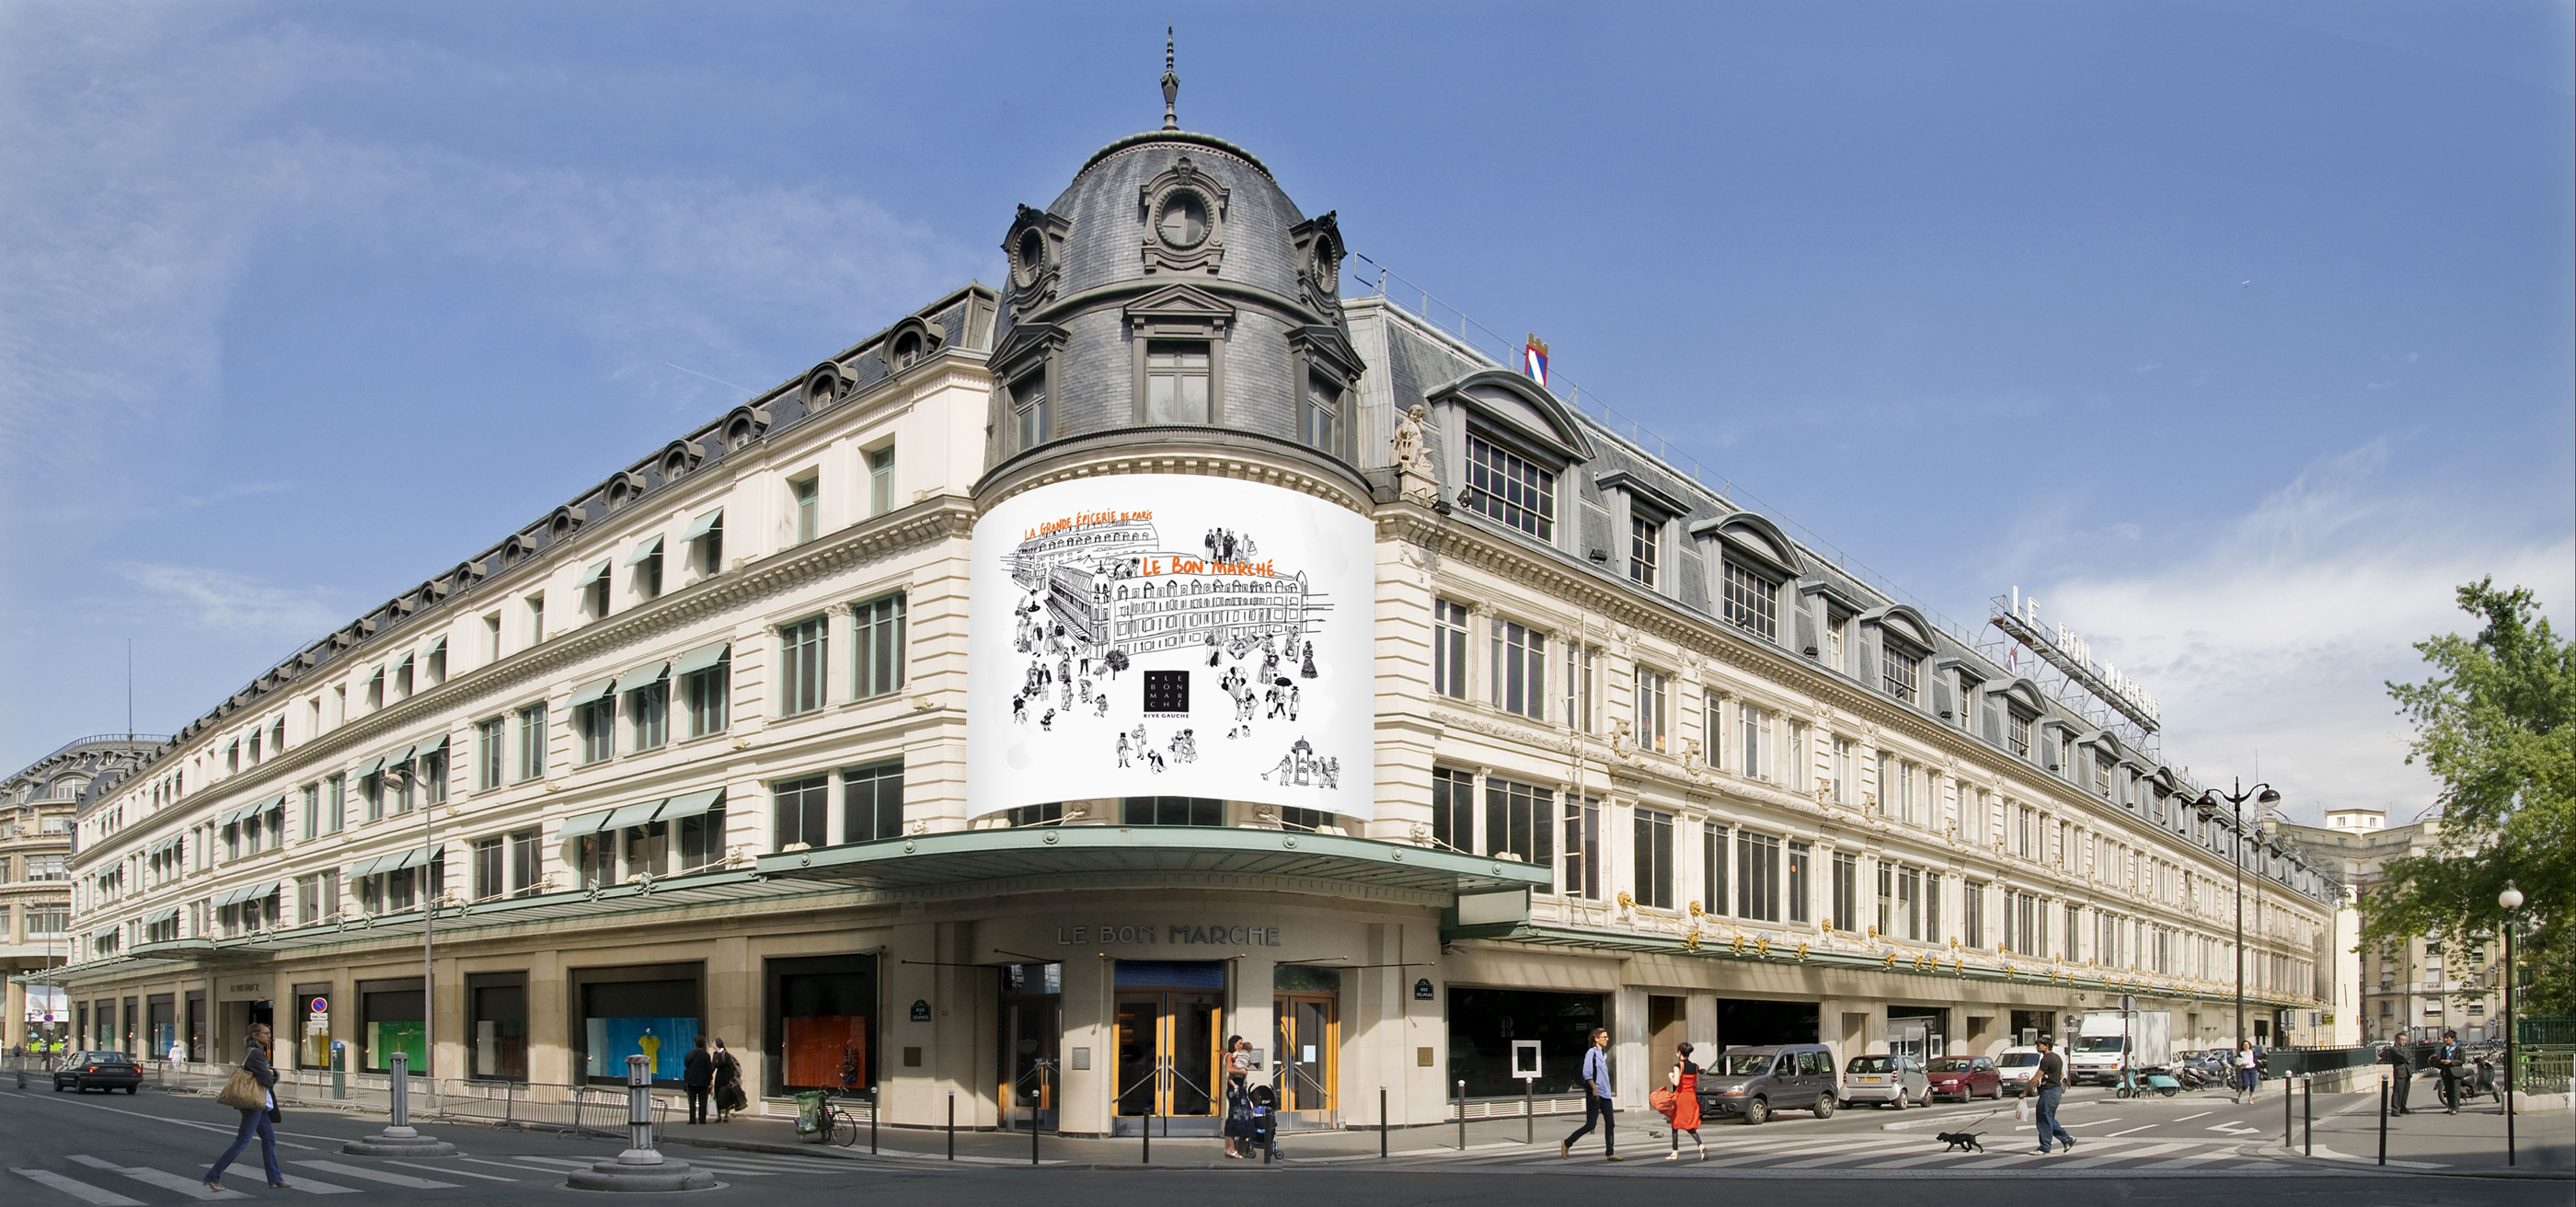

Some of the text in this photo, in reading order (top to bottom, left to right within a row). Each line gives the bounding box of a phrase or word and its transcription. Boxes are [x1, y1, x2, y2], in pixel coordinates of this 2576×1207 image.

[1024, 528, 1036, 541] LA
[1040, 517, 1073, 535] GRANDE
[1121, 512, 1130, 522] DE
[1143, 556, 1275, 577] LE BON MARCHÉ
[2013, 585, 2040, 633] LE
[2059, 621, 2090, 672] BON
[1058, 925, 1281, 947] LE BON MARCHE
